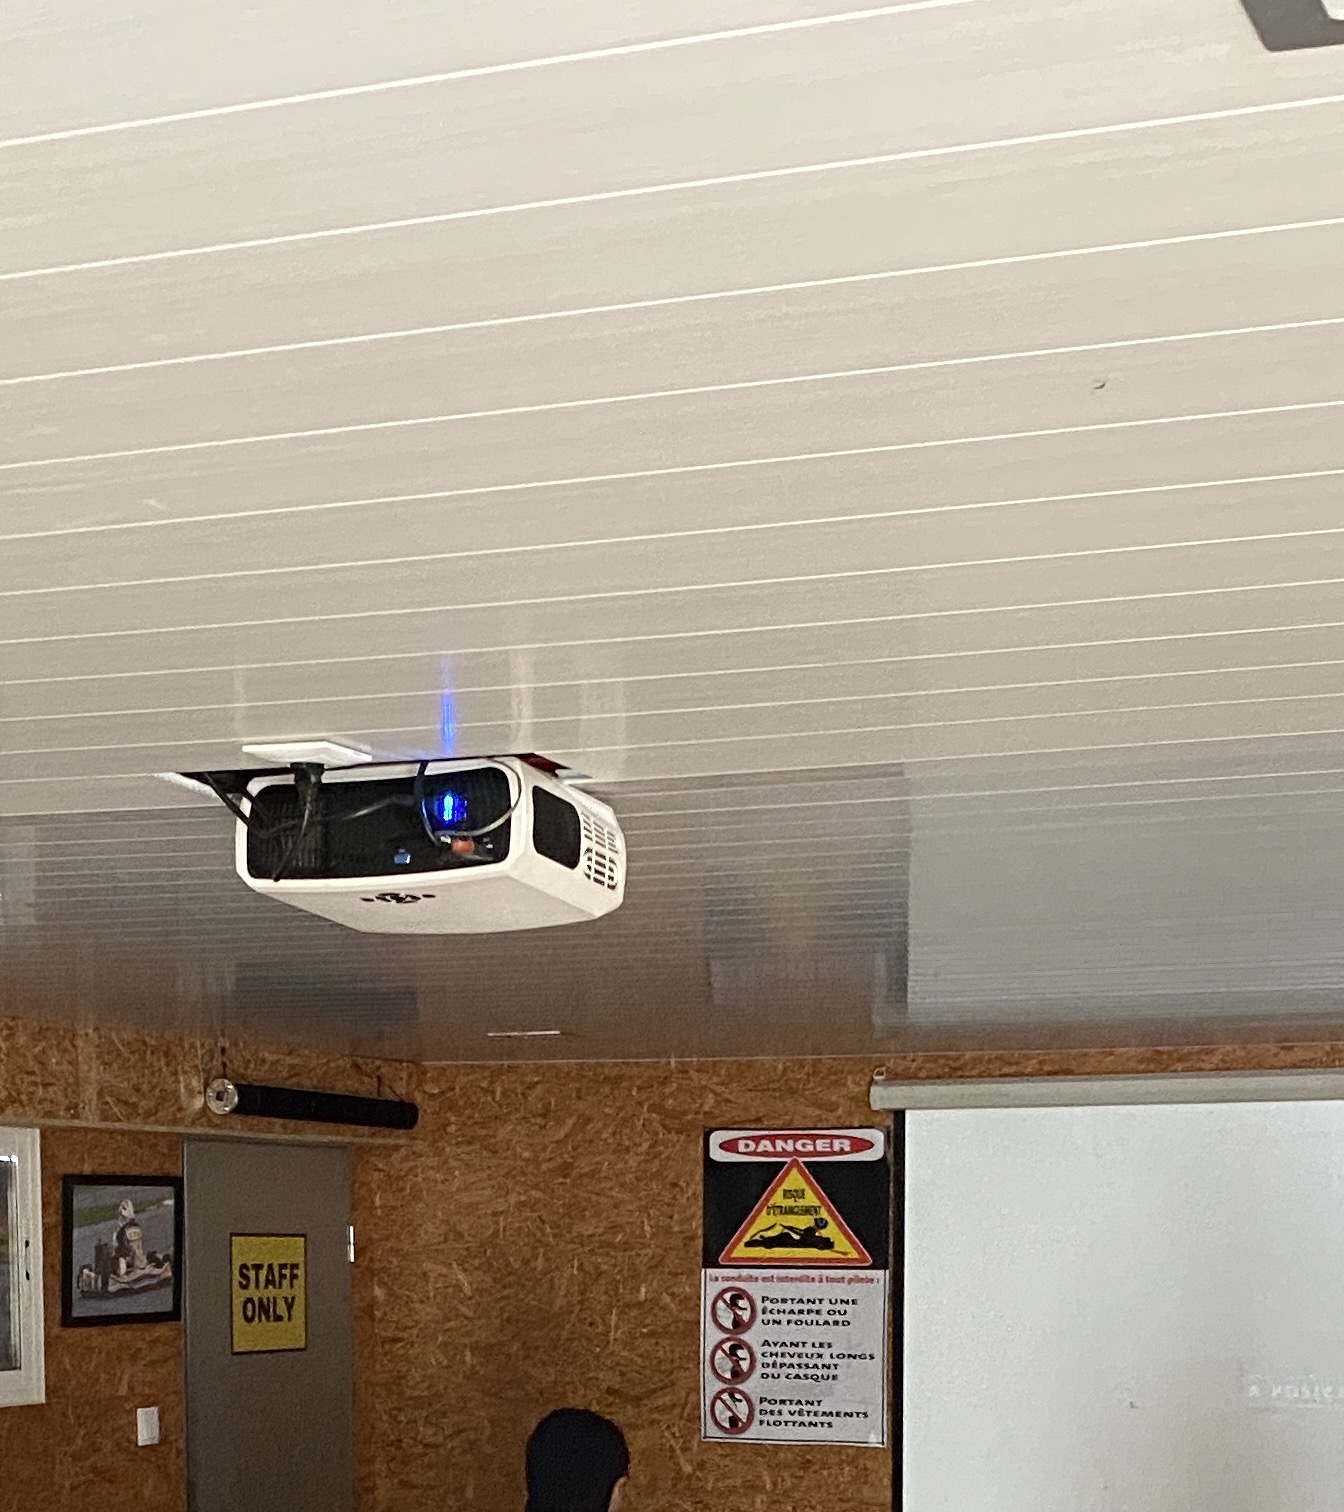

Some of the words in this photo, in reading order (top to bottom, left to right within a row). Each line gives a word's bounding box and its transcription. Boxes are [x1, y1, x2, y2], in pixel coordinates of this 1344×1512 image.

[737, 1139, 851, 1153] DANGER
[238, 1262, 300, 1290] STAFF
[761, 1296, 824, 1305] PORTANT
[242, 1295, 296, 1324] ONLY
[761, 1306, 822, 1316] ÉCHARPE
[827, 1308, 848, 1316] OU
[787, 1319, 851, 1327] FOULARD
[761, 1339, 807, 1349] AYANT
[760, 1352, 825, 1360] CHEVEUX
[761, 1361, 840, 1370] DÉPASSANT
[785, 1373, 839, 1383] CASQUE
[759, 1397, 823, 1406] PORTANT
[759, 1409, 783, 1417] DES
[788, 1408, 869, 1419] VÊTEMENTS
[759, 1420, 834, 1429] FLOTTANTS
